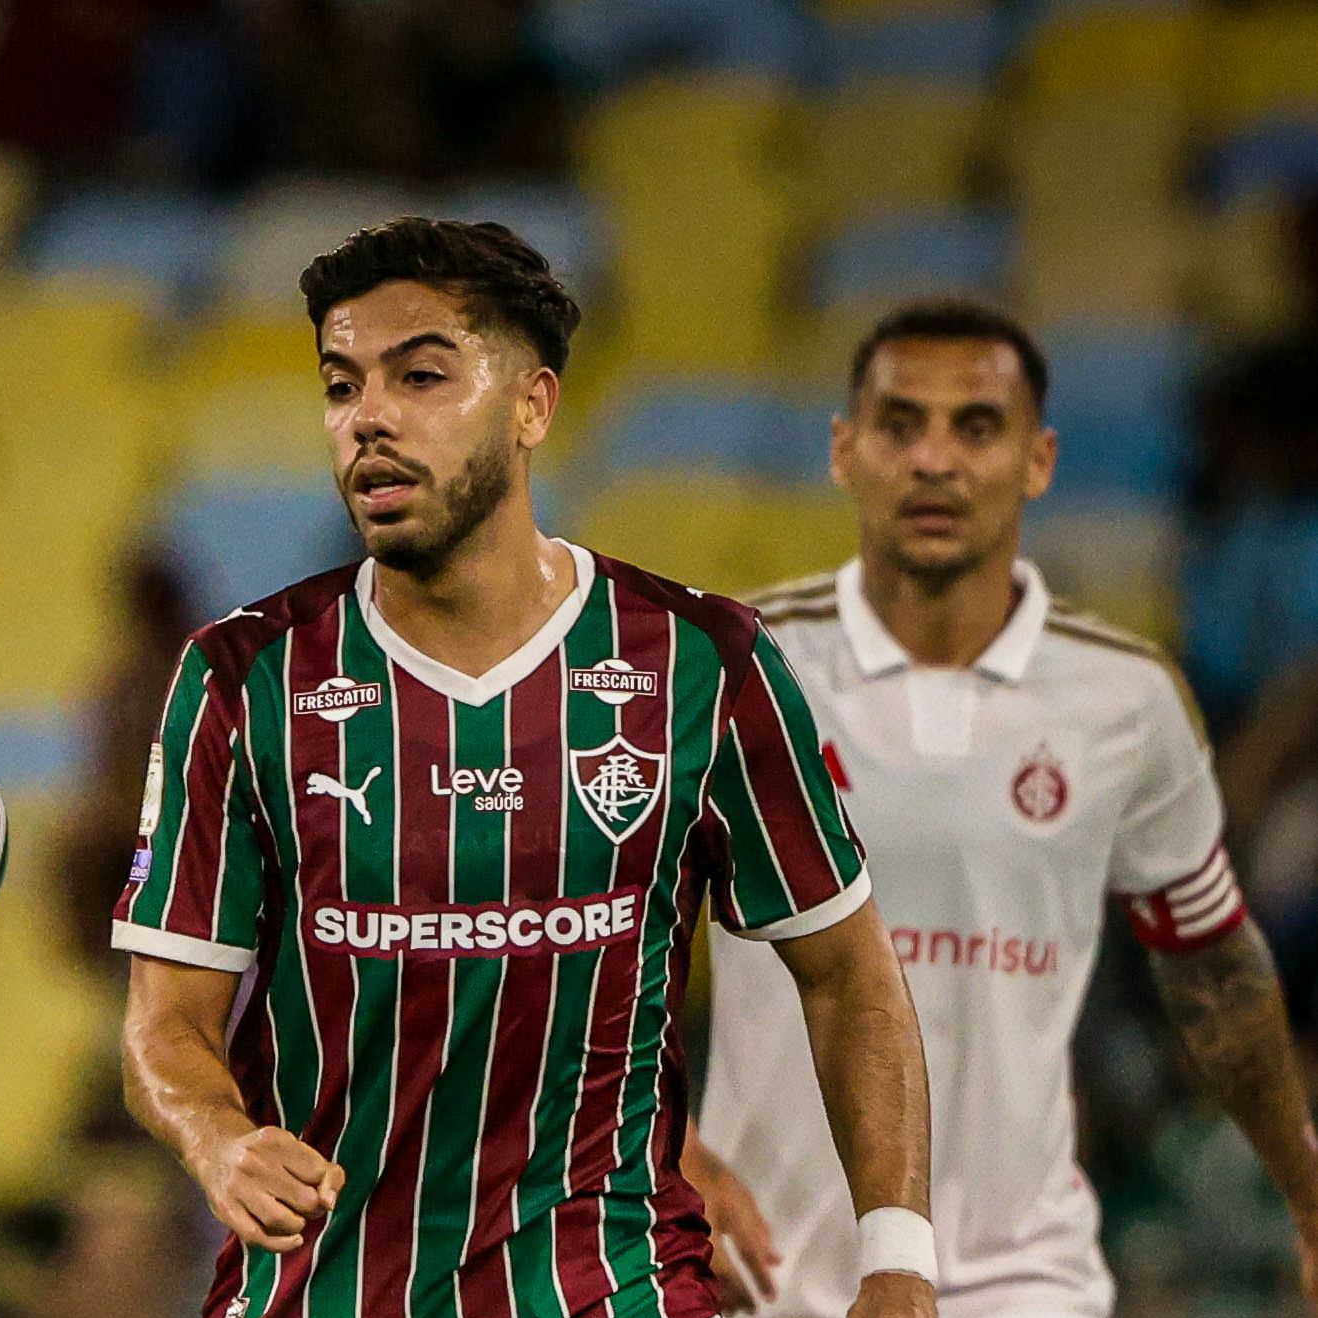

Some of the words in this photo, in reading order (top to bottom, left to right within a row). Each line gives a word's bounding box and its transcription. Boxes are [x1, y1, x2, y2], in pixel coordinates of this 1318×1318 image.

[574, 673, 653, 692] FRESCATTO
[298, 688, 376, 711] FRESCATTO
[431, 764, 523, 795] Leve
[474, 792, 524, 811] saúde
[314, 894, 636, 951] SUPERSCORE
